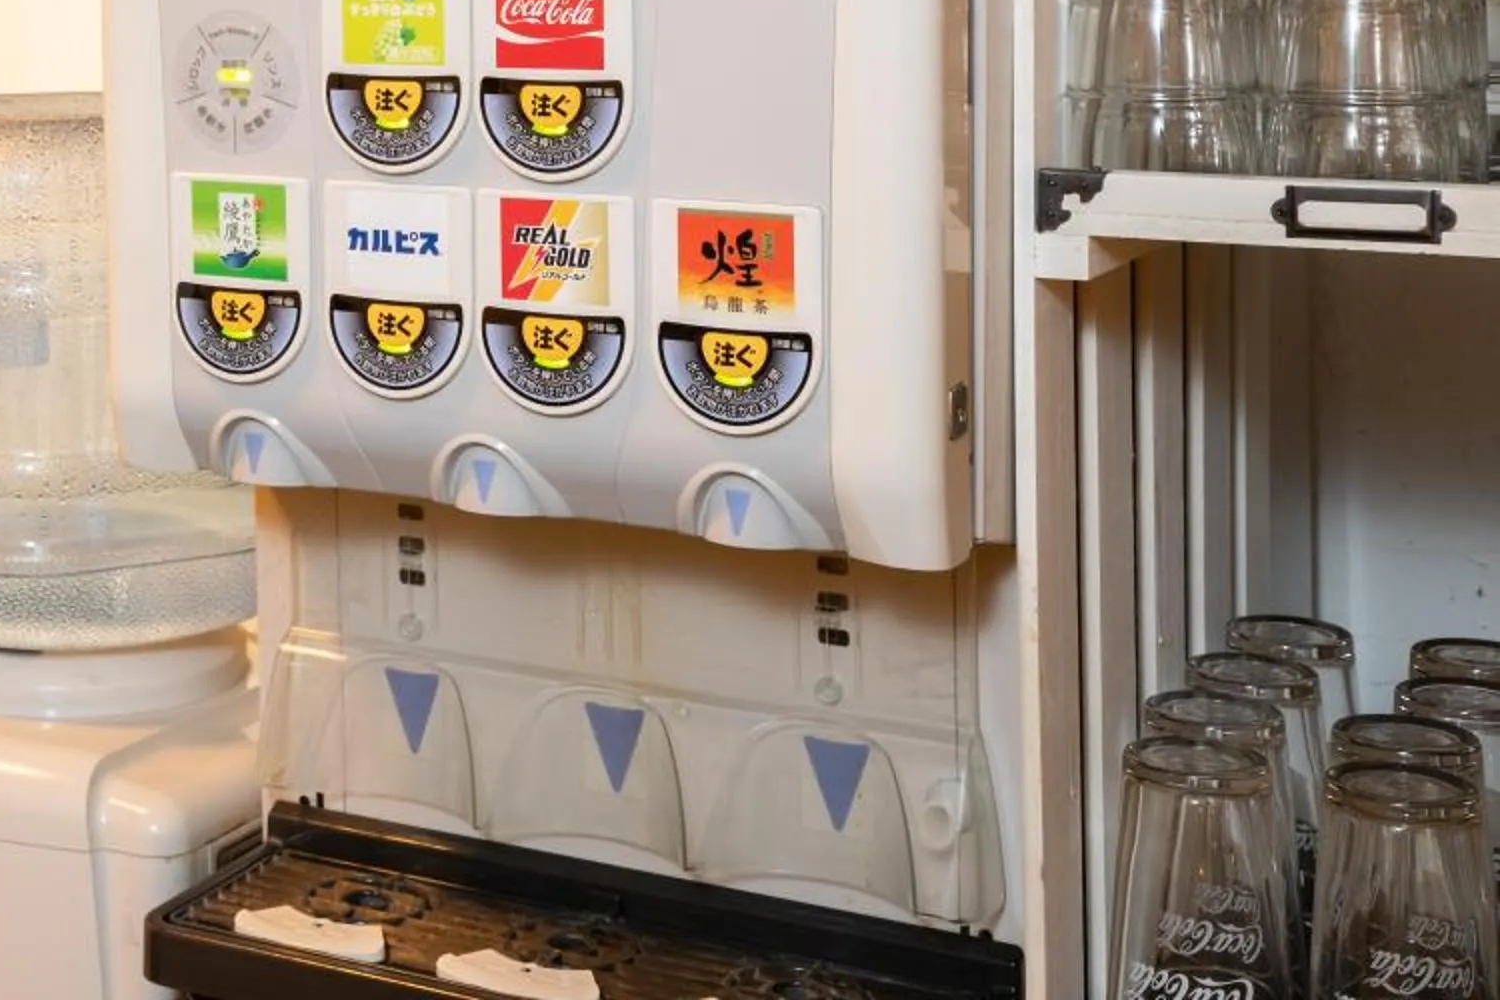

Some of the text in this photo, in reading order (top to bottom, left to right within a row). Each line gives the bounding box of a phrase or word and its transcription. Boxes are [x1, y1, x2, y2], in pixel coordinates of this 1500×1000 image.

[374, 87, 413, 112] 注ぐ
[531, 92, 571, 118] 注ぐ
[347, 226, 440, 256] カルピス
[515, 222, 571, 246] REAL
[543, 246, 592, 269] GOLD
[697, 228, 763, 287] 煌
[221, 299, 256, 324] 注ぐ
[377, 311, 415, 337] 注ぐ
[533, 325, 573, 351] 注ぐ
[714, 341, 757, 368] 注ぐ
